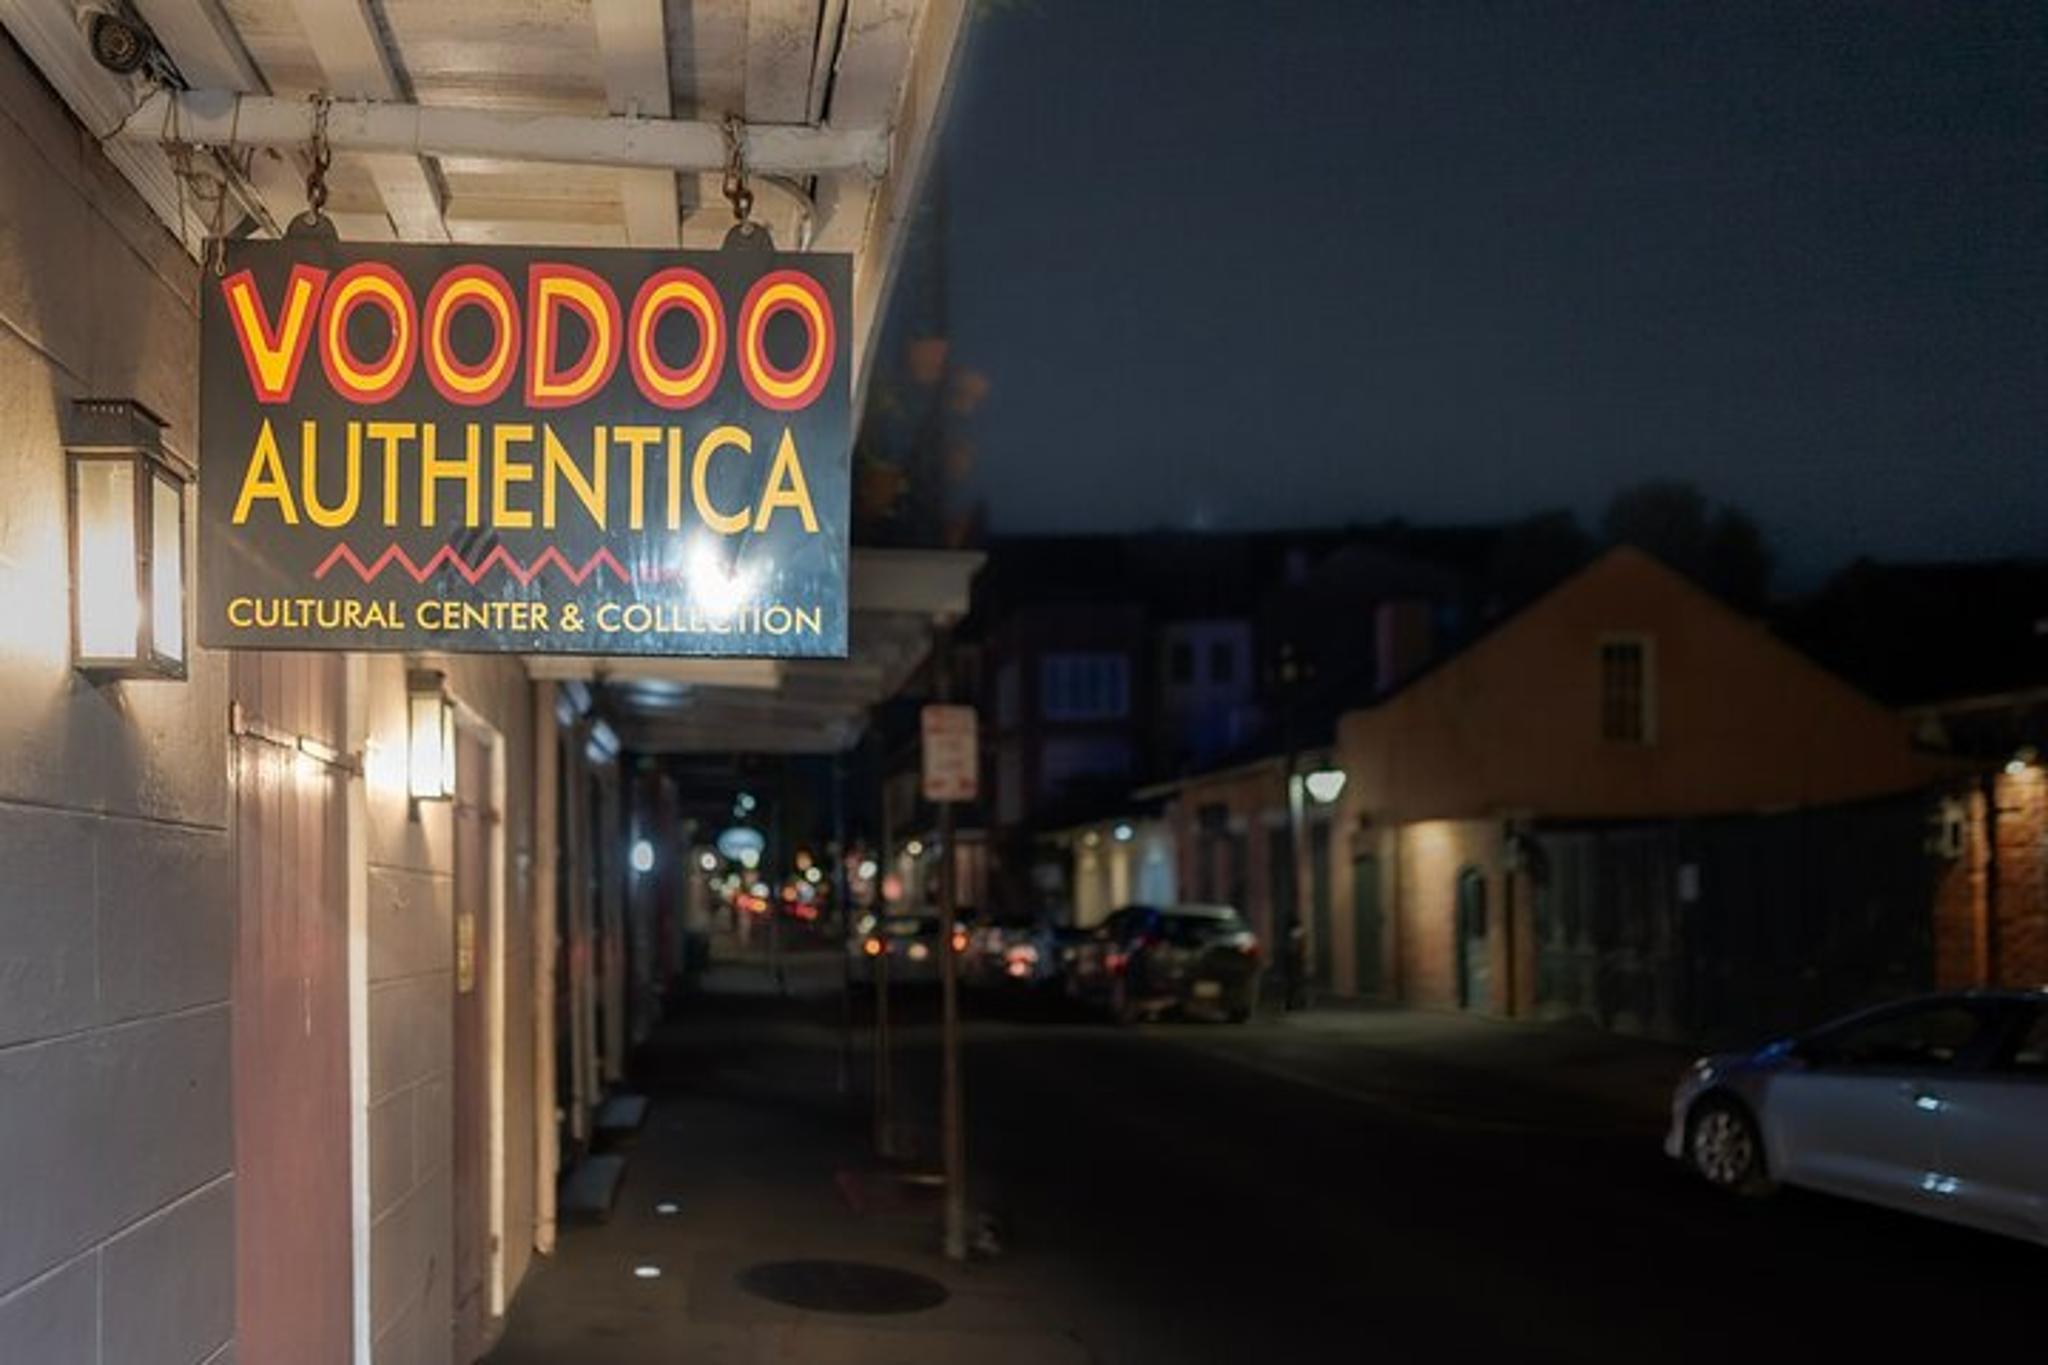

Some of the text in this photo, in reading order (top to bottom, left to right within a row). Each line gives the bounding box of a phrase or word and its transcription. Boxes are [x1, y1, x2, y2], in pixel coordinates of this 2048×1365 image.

[222, 262, 836, 411] VOODOO
[231, 418, 820, 534] AUTHENTICA
[228, 597, 405, 631] CULTURAL
[416, 601, 550, 632] CENTER
[560, 603, 586, 631] &
